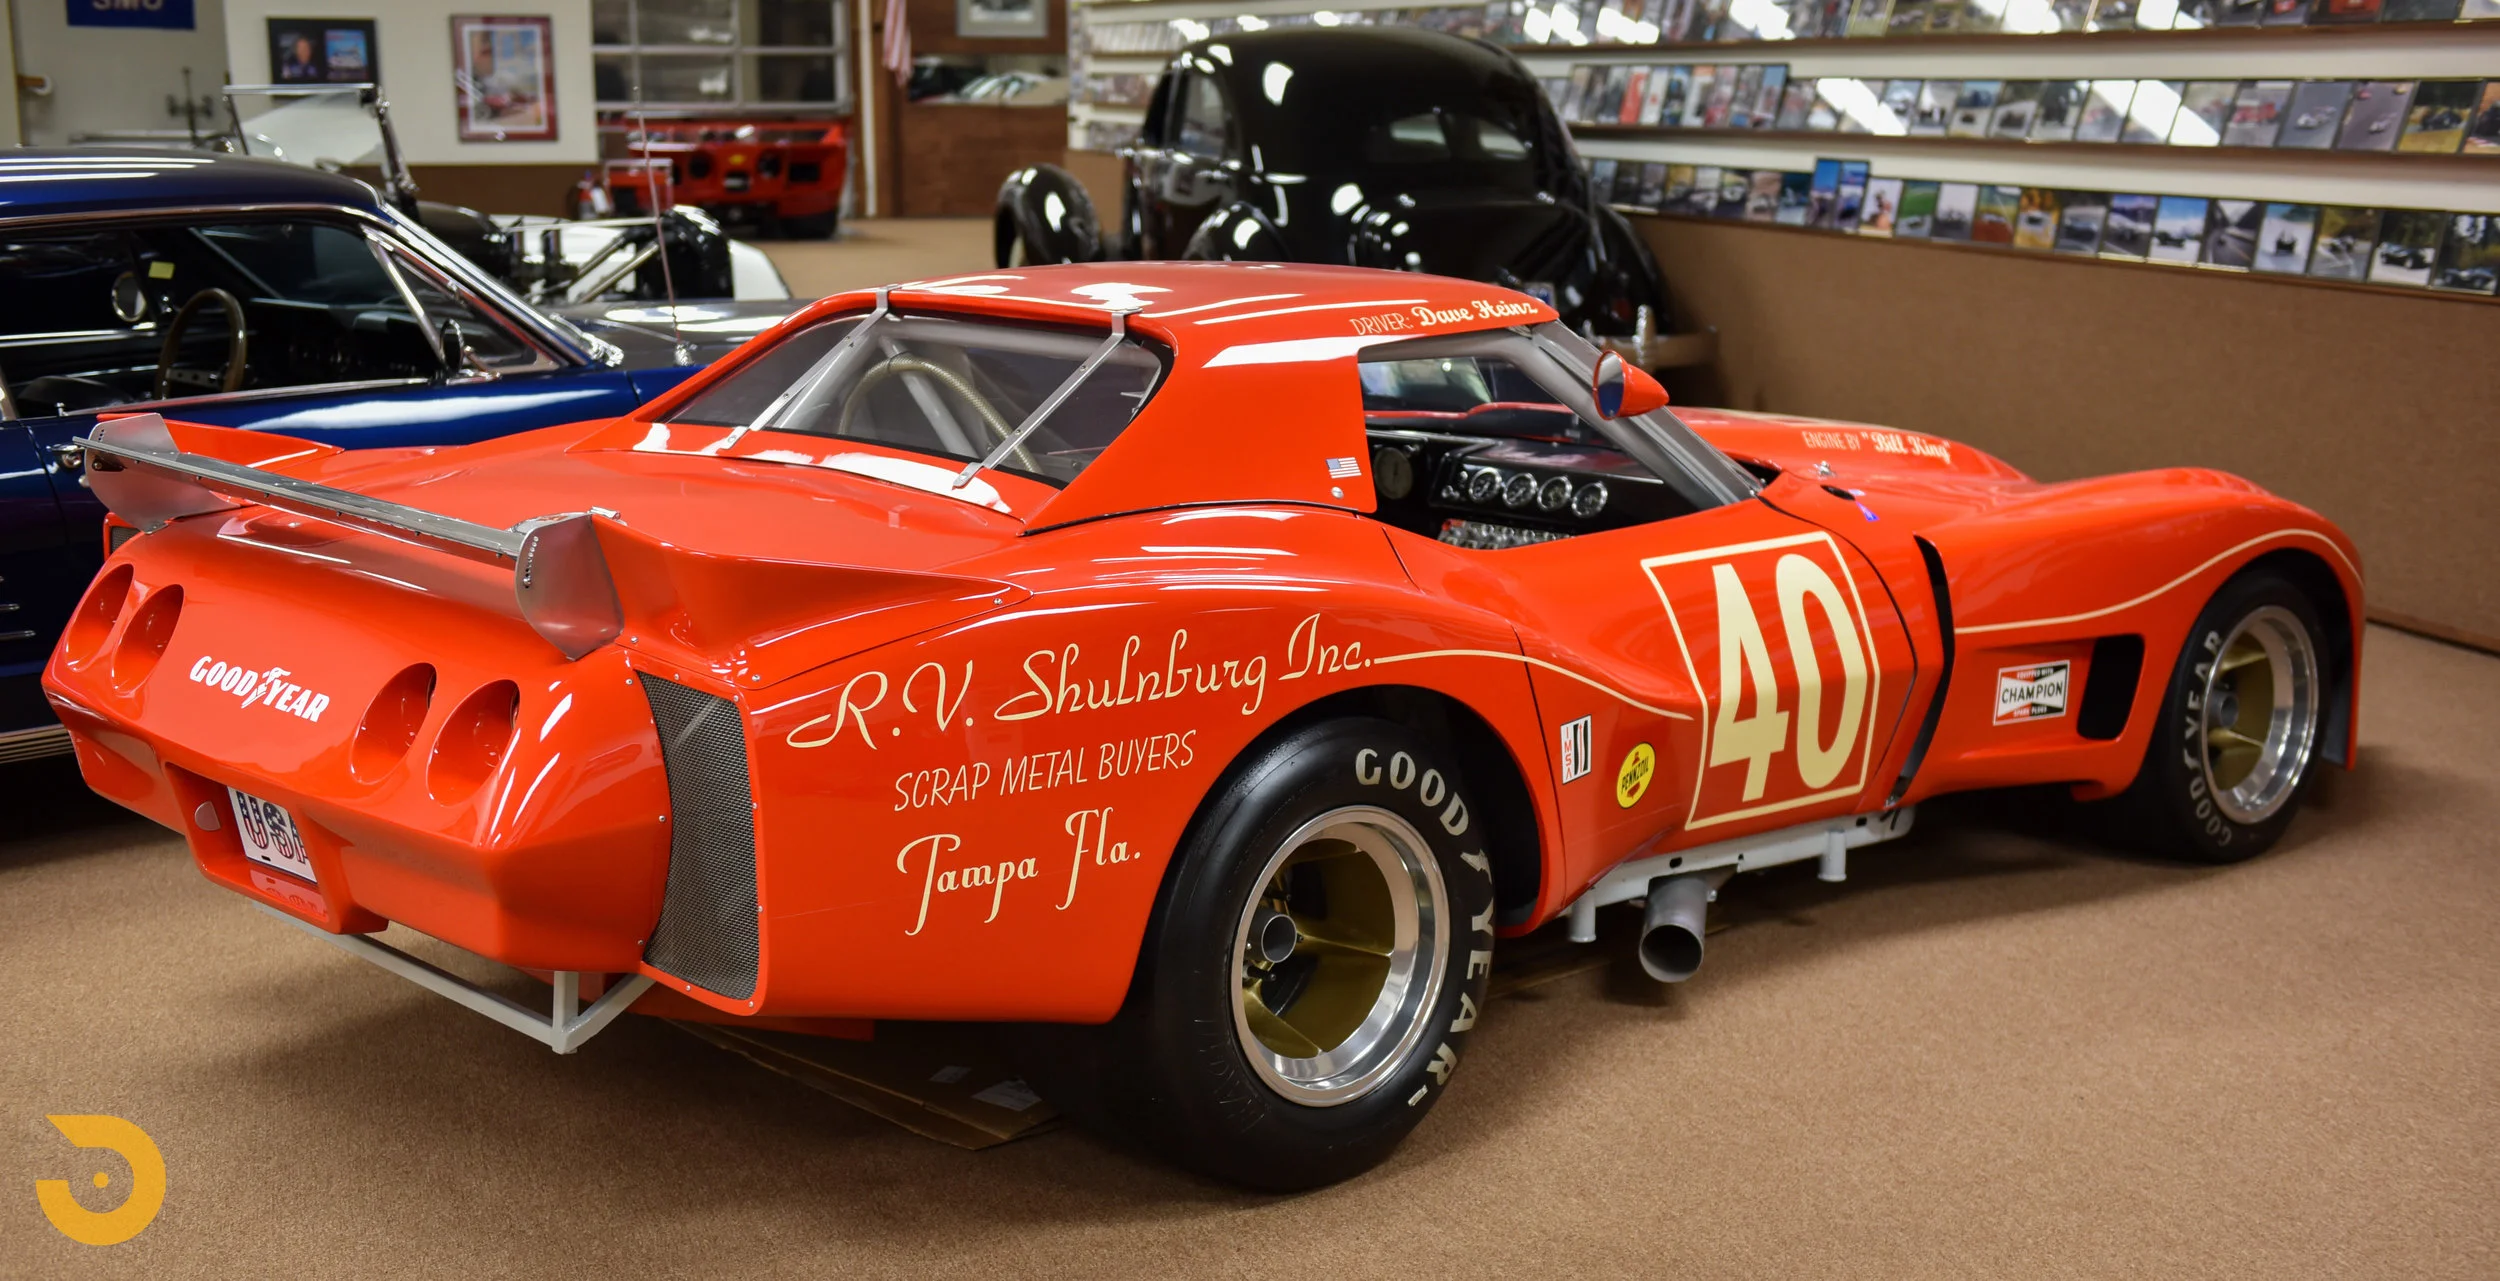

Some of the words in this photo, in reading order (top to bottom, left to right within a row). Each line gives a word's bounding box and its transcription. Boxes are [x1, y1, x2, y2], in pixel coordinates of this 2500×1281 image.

[1349, 313, 1414, 335] DRIVER:
[1411, 306, 1474, 327] Dave
[1471, 300, 1538, 319] Heinz
[1802, 430, 1846, 450] ENGINE
[1845, 433, 1861, 451] BY
[993, 629, 1266, 720] Shulnburg
[1278, 612, 1371, 681] Inc.
[1710, 553, 1867, 802] 40
[2002, 682, 2063, 703] CHAMPION
[894, 762, 990, 812] SCRAP
[1000, 747, 1088, 796] METAL
[1098, 729, 1197, 781] BUYERS
[1564, 726, 1573, 780] IMSA
[1621, 756, 1649, 794] PENNZOIL
[896, 833, 1038, 936] Tampa
[1055, 807, 1141, 910] Fla.
